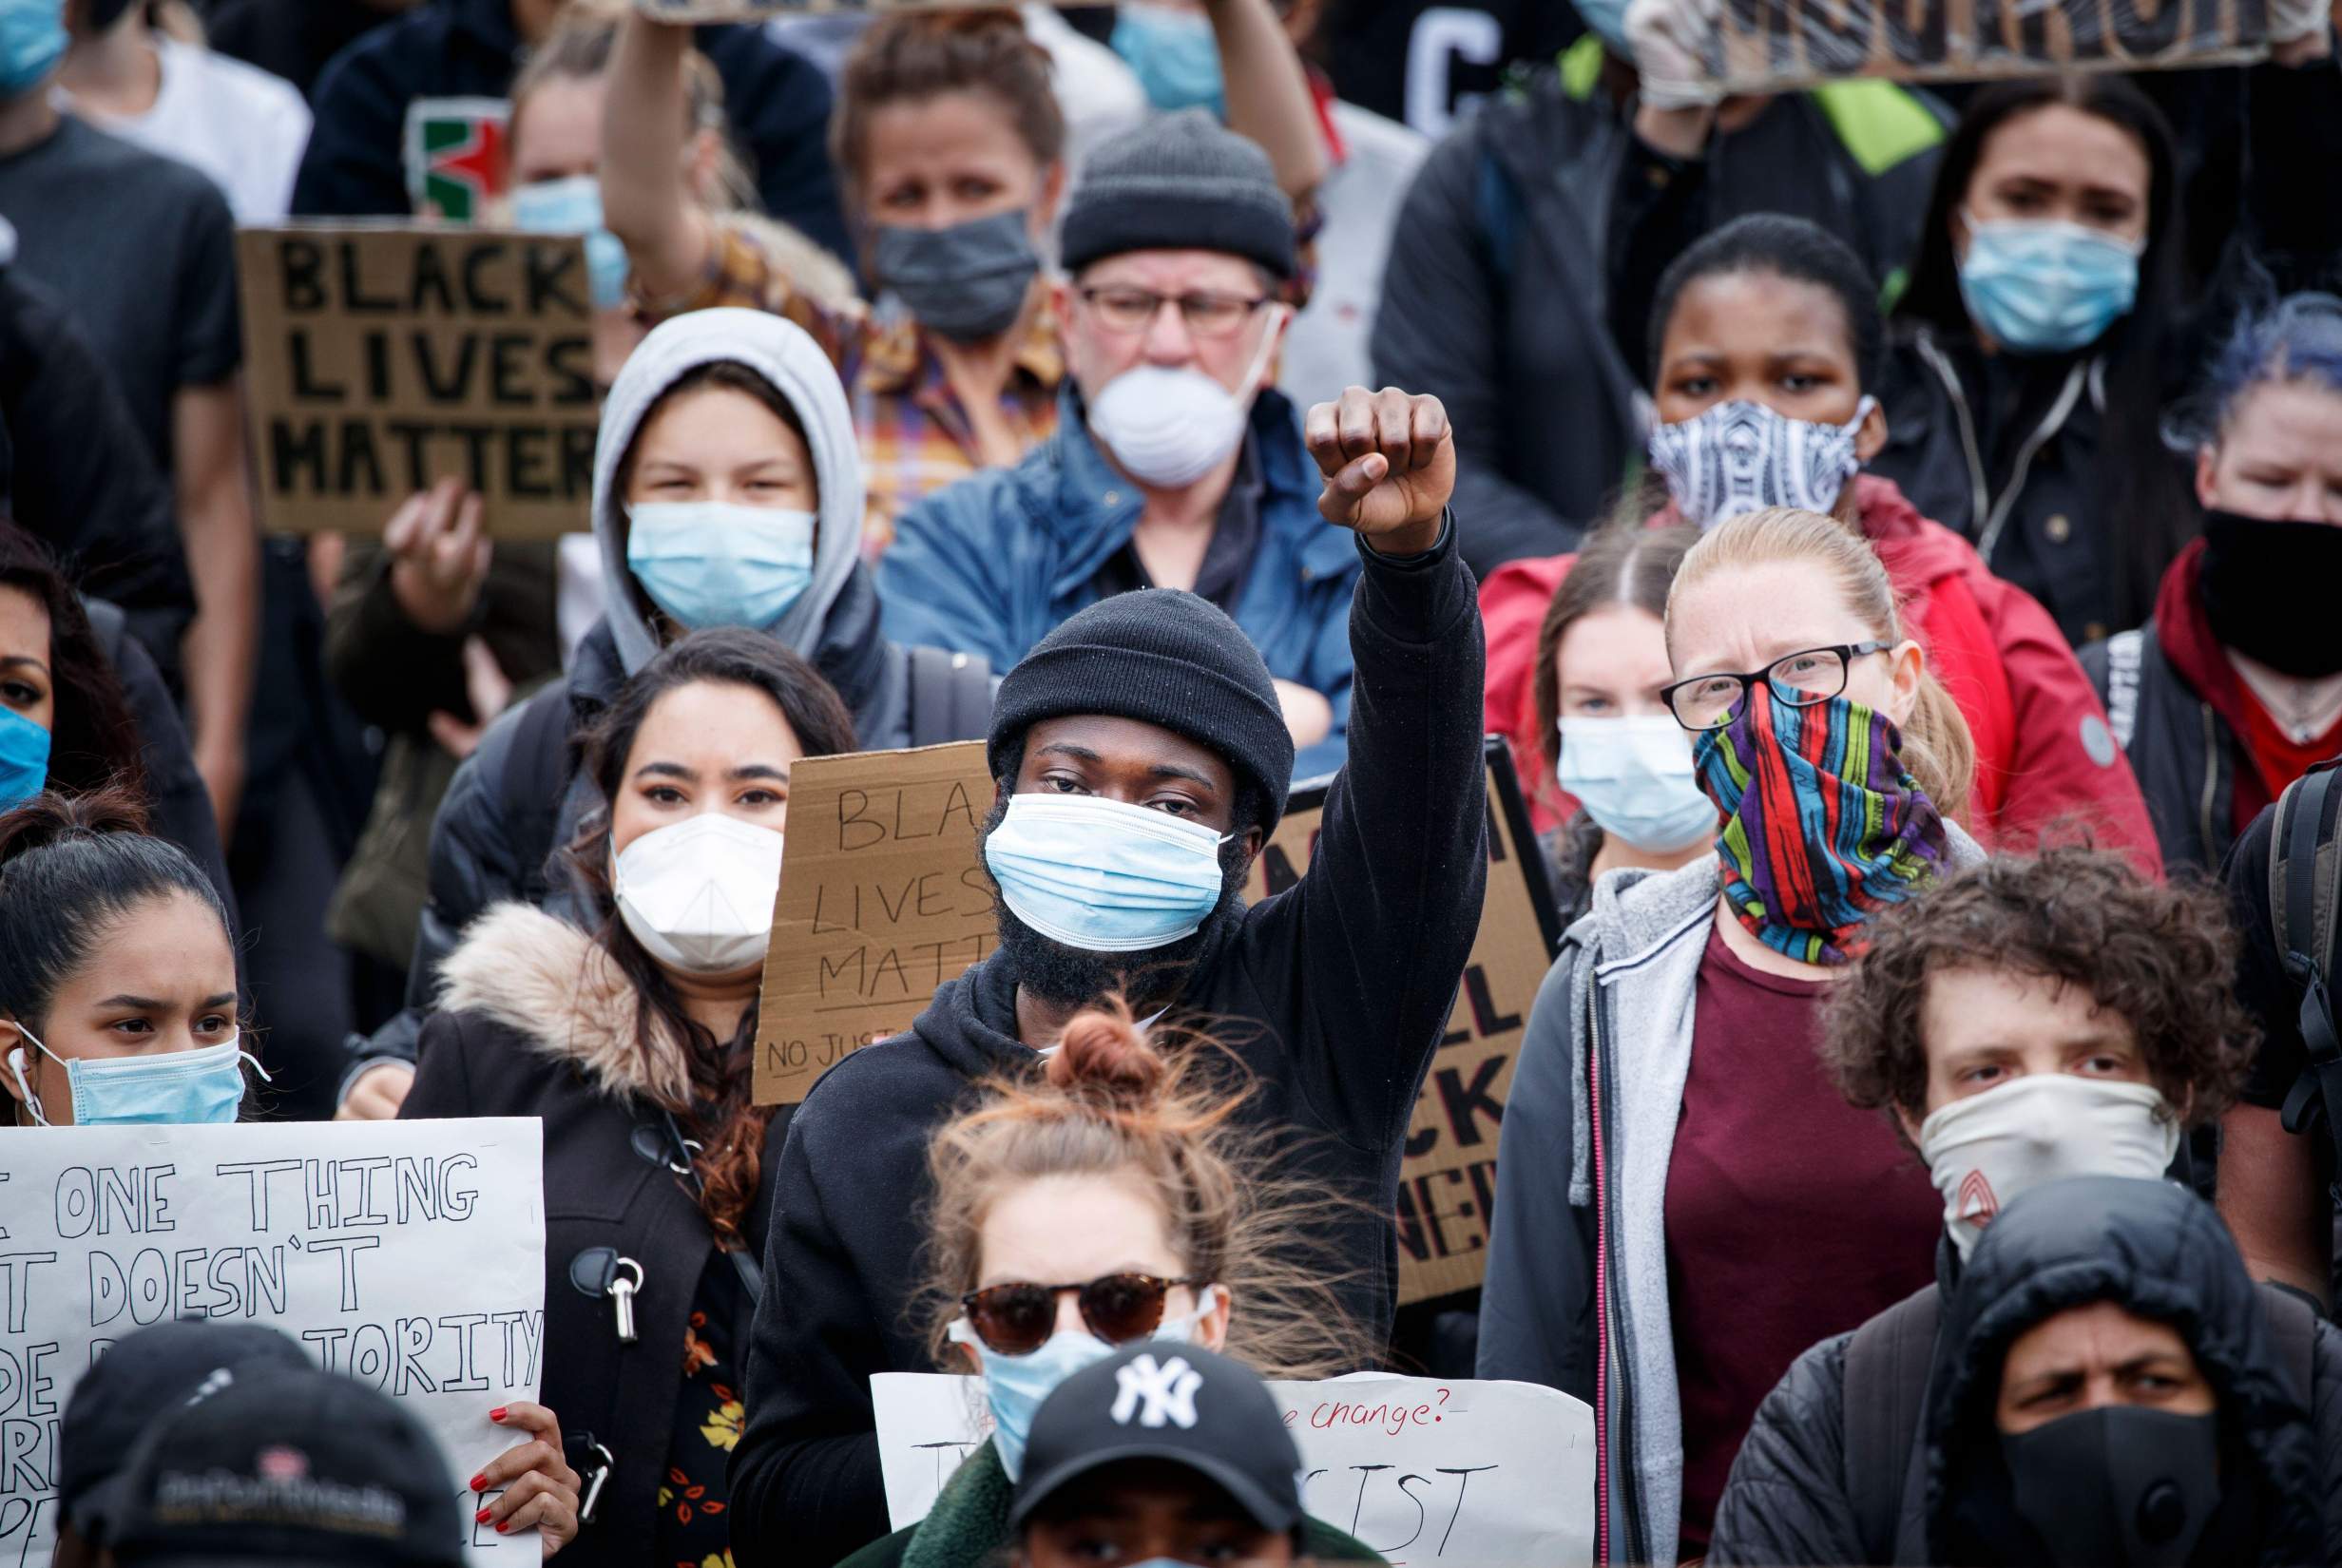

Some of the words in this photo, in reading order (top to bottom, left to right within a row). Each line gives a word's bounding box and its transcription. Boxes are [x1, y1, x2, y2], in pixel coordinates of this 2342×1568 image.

[278, 239, 588, 315] BLACK
[290, 329, 594, 409] LIVES
[270, 416, 594, 501] MATTER
[838, 781, 979, 851] BLA
[812, 866, 995, 935] LIVES
[819, 933, 996, 999] MATT
[767, 1040, 807, 1072] NO
[55, 1164, 176, 1238] ONE
[216, 1153, 478, 1233] THING
[89, 1235, 380, 1328] DOESN'T
[1110, 1353, 1203, 1428] NY
[1311, 1388, 1450, 1436] change?
